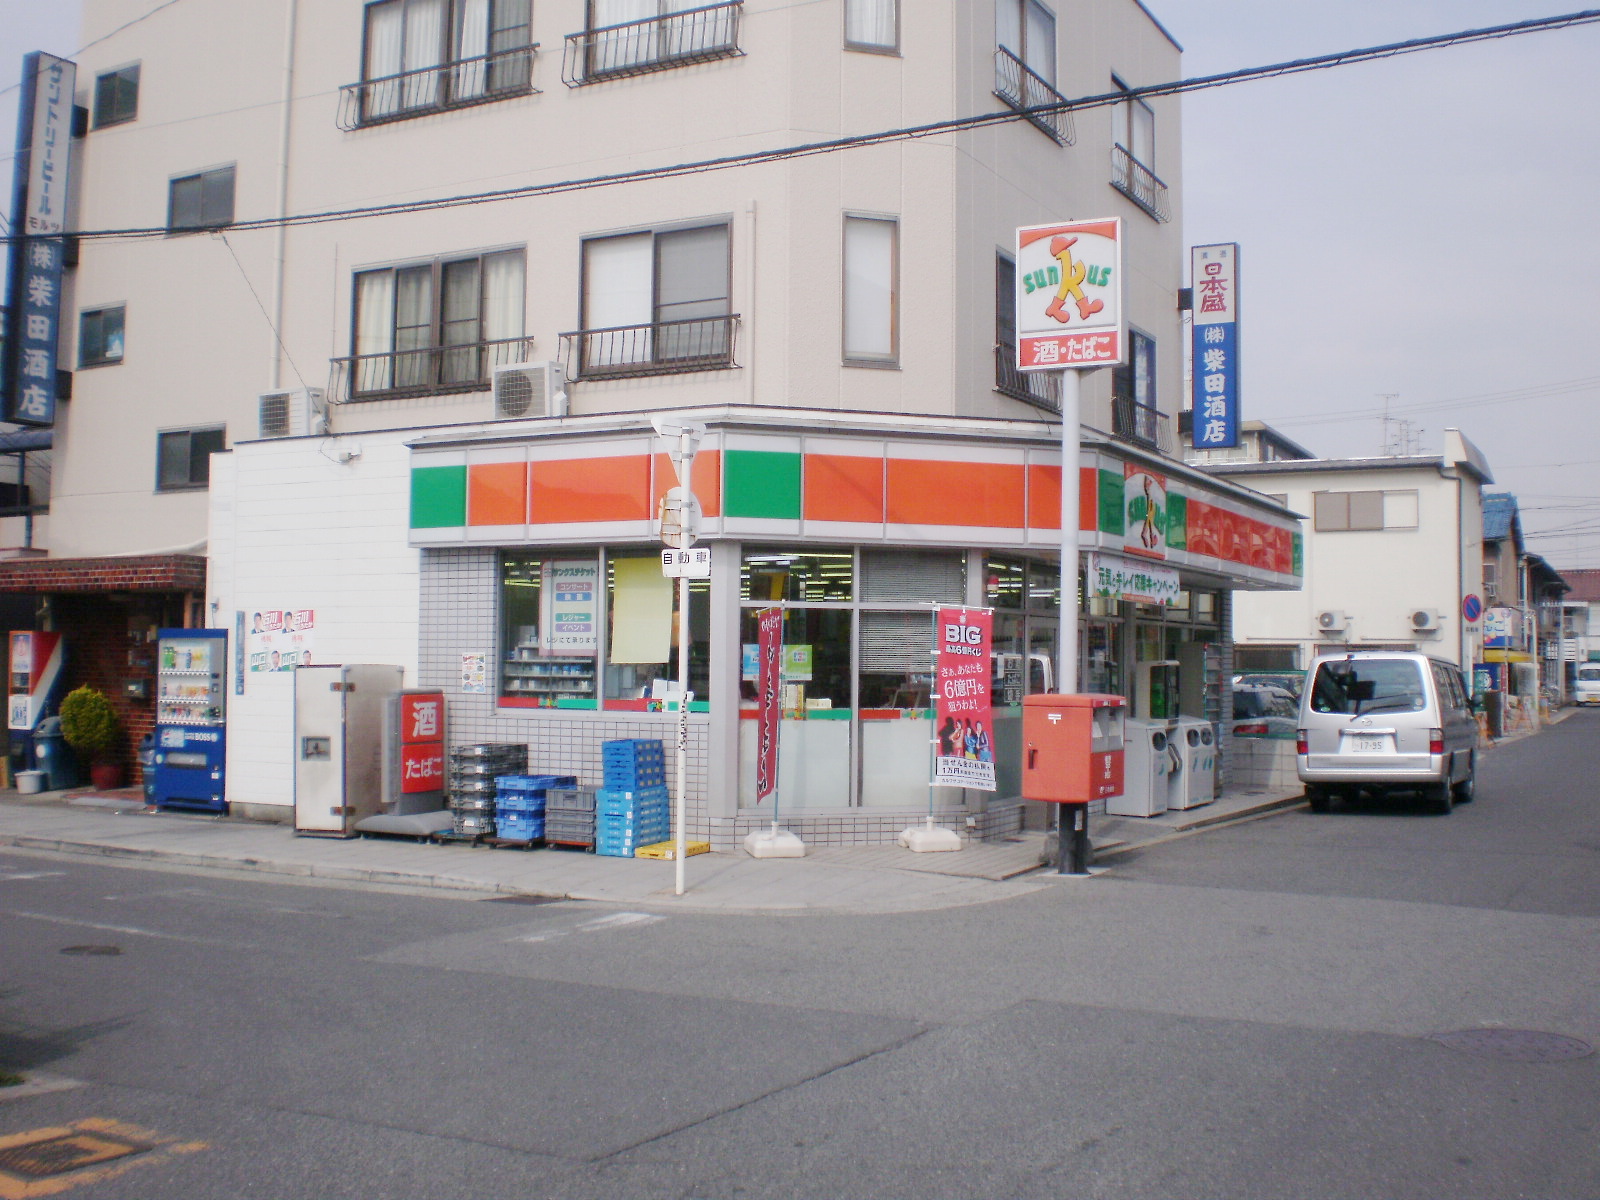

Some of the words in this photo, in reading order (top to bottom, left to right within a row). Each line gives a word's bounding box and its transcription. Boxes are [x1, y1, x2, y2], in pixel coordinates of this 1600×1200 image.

[28, 216, 60, 233] モルツ
[663, 552, 707, 564] 自動車
[945, 624, 982, 644] BIG
[412, 702, 437, 737] 酒
[405, 757, 442, 779] たばこ
